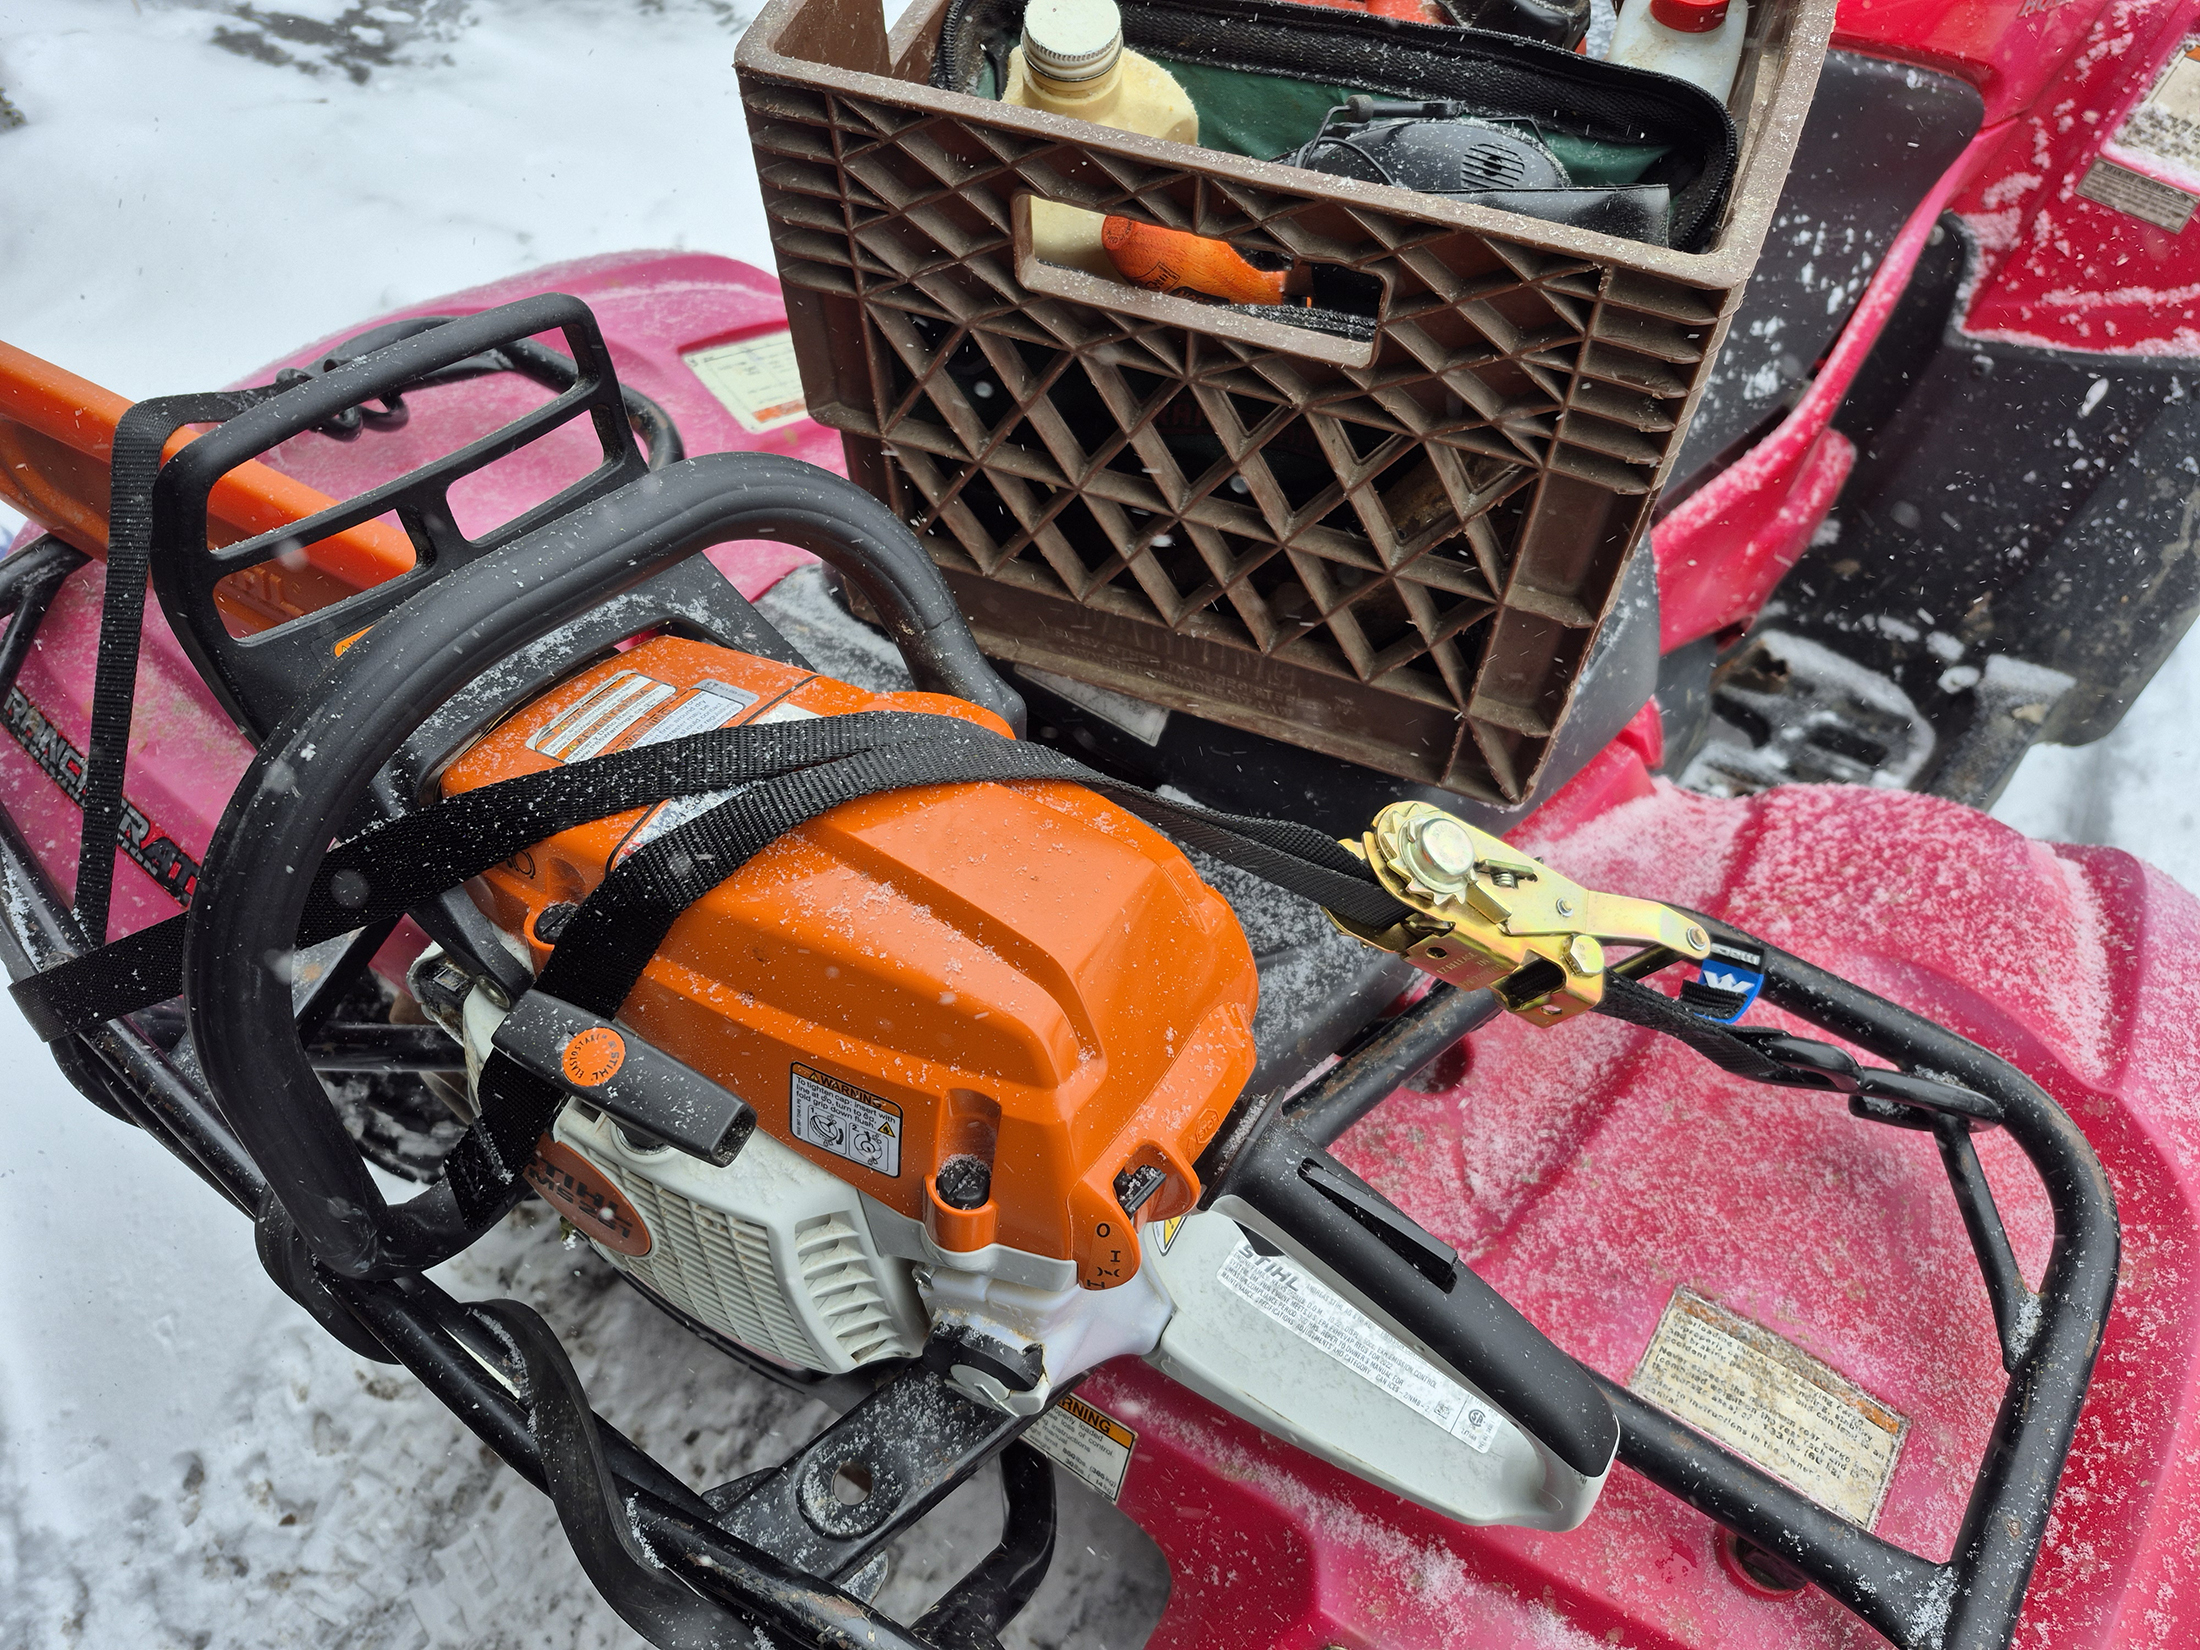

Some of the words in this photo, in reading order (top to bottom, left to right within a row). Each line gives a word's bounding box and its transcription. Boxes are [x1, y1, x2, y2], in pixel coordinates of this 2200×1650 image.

[624, 708, 672, 748] WARNING
[3, 686, 152, 849] RANCR
[593, 1052, 619, 1080] STIHL
[796, 1077, 806, 1086] To
[807, 1081, 833, 1098] tighten
[854, 1102, 876, 1116] insert
[879, 1112, 895, 1124] with
[796, 1085, 810, 1095] line
[811, 1091, 819, 1099] at
[836, 1102, 852, 1112] turn
[853, 1108, 861, 1117] to
[820, 1075, 882, 1108] WARNING
[796, 1091, 811, 1102] fold
[813, 1099, 829, 1110] grip
[830, 1105, 853, 1120] down
[855, 1115, 876, 1129] flush.
[1198, 1115, 1219, 1139] STOP
[528, 1157, 633, 1227] TIHL
[1238, 1244, 1299, 1292] STIHL
[1246, 1280, 1278, 1305] COMPLIANCE
[1320, 1329, 1338, 1344] REFER
[1337, 1340, 1346, 1349] TO
[1369, 1360, 1393, 1379] MANUAL
[1391, 1374, 1404, 1386] FOR
[1271, 1287, 1290, 1303] ENGINE
[1289, 1300, 1309, 1316] MEETS
[1317, 1318, 1329, 1328] EPA
[1367, 1350, 1380, 1361] FOR
[1331, 1345, 1344, 1357] AND
[1342, 1353, 1371, 1375] CATEGORY
[1374, 1373, 1388, 1385] CAN
[1658, 1345, 1687, 1364] Never
[1412, 1369, 1438, 1389] CONTROL
[1050, 1406, 1075, 1424] roperly
[1077, 1421, 1104, 1441] loaded
[1059, 1396, 1111, 1434] RNING
[1059, 1419, 1076, 1432] loss
[1077, 1430, 1085, 1438] of
[1041, 1425, 1069, 1444] manual
[1051, 1422, 1091, 1452] instructions
[1750, 1432, 1761, 1442] in
[1815, 1411, 1834, 1426] can
[1872, 1448, 1885, 1460] an
